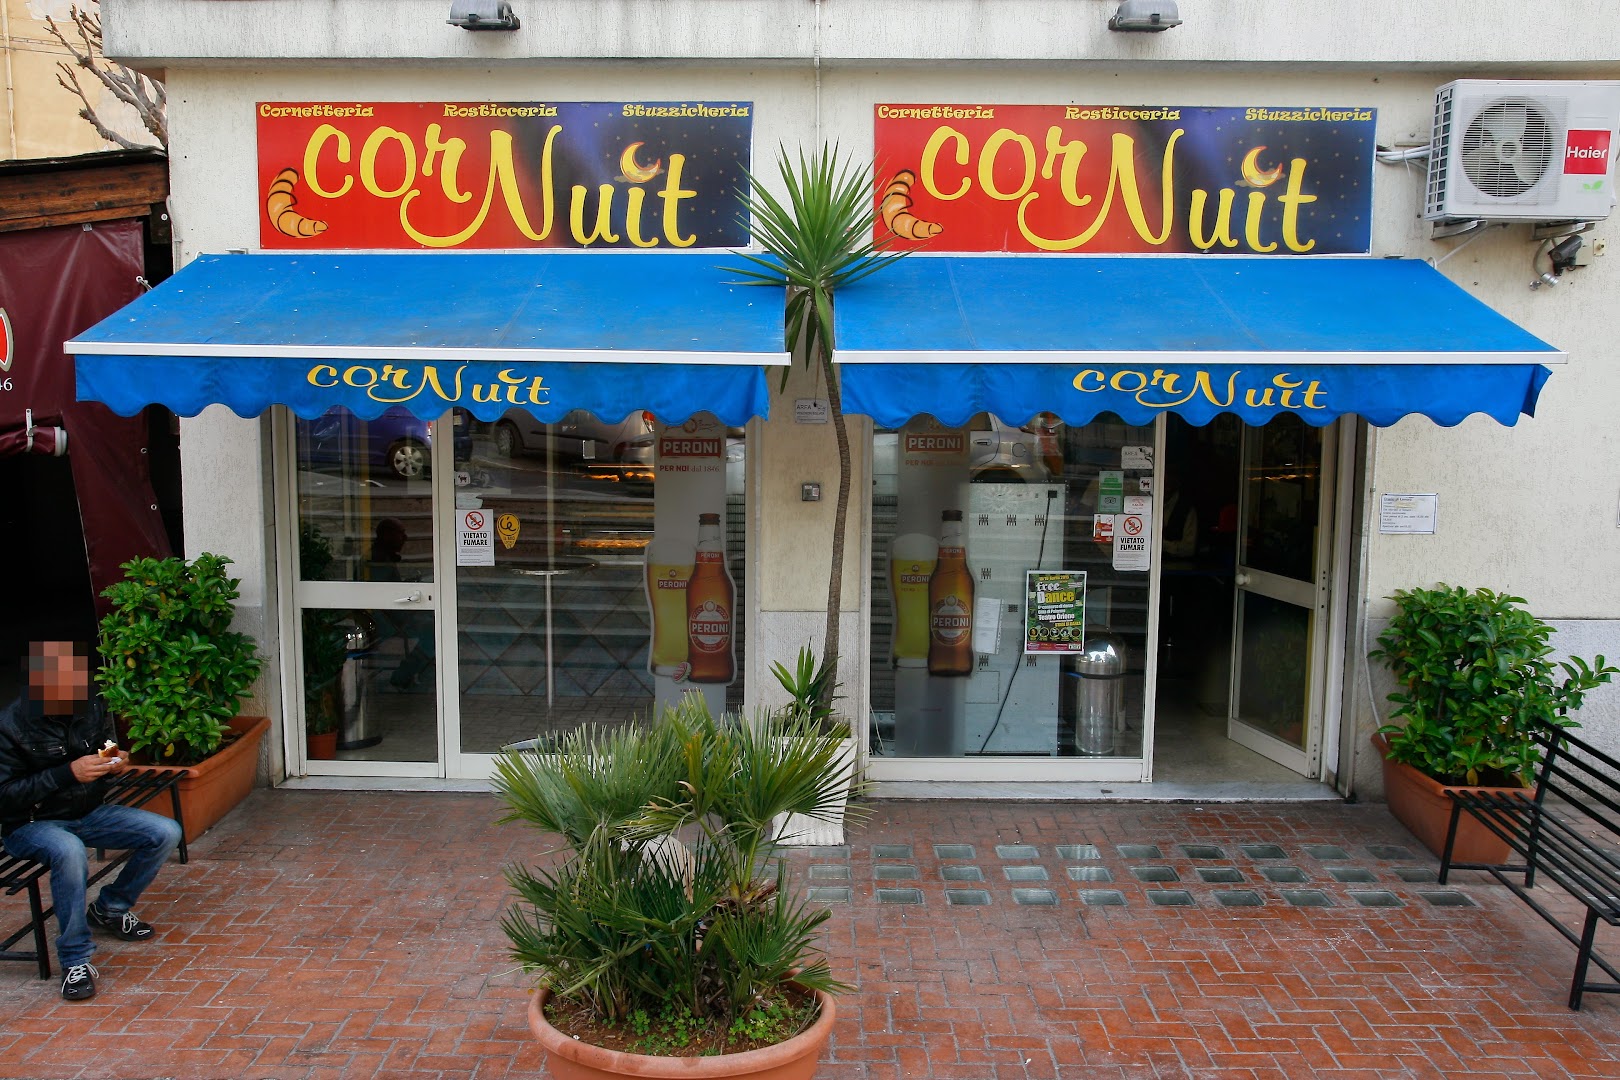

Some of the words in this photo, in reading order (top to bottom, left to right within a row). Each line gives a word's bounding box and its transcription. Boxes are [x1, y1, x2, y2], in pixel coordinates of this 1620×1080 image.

[259, 103, 374, 117] Cornetteria
[443, 103, 557, 117] Rosticceria
[622, 104, 749, 117] Stuzzicheria
[878, 106, 994, 120] Cornetteria
[1065, 106, 1181, 121] Rosticceria
[1245, 107, 1372, 122] Stuzzicheria
[1566, 146, 1607, 159] Haier
[662, 441, 718, 454] PERONI
[908, 437, 960, 449] PERONI
[658, 580, 687, 589] PERONI
[1036, 582, 1060, 592] free
[1037, 592, 1075, 603] Dance
[690, 622, 729, 633] PERONI
[932, 617, 969, 627] PERONI
